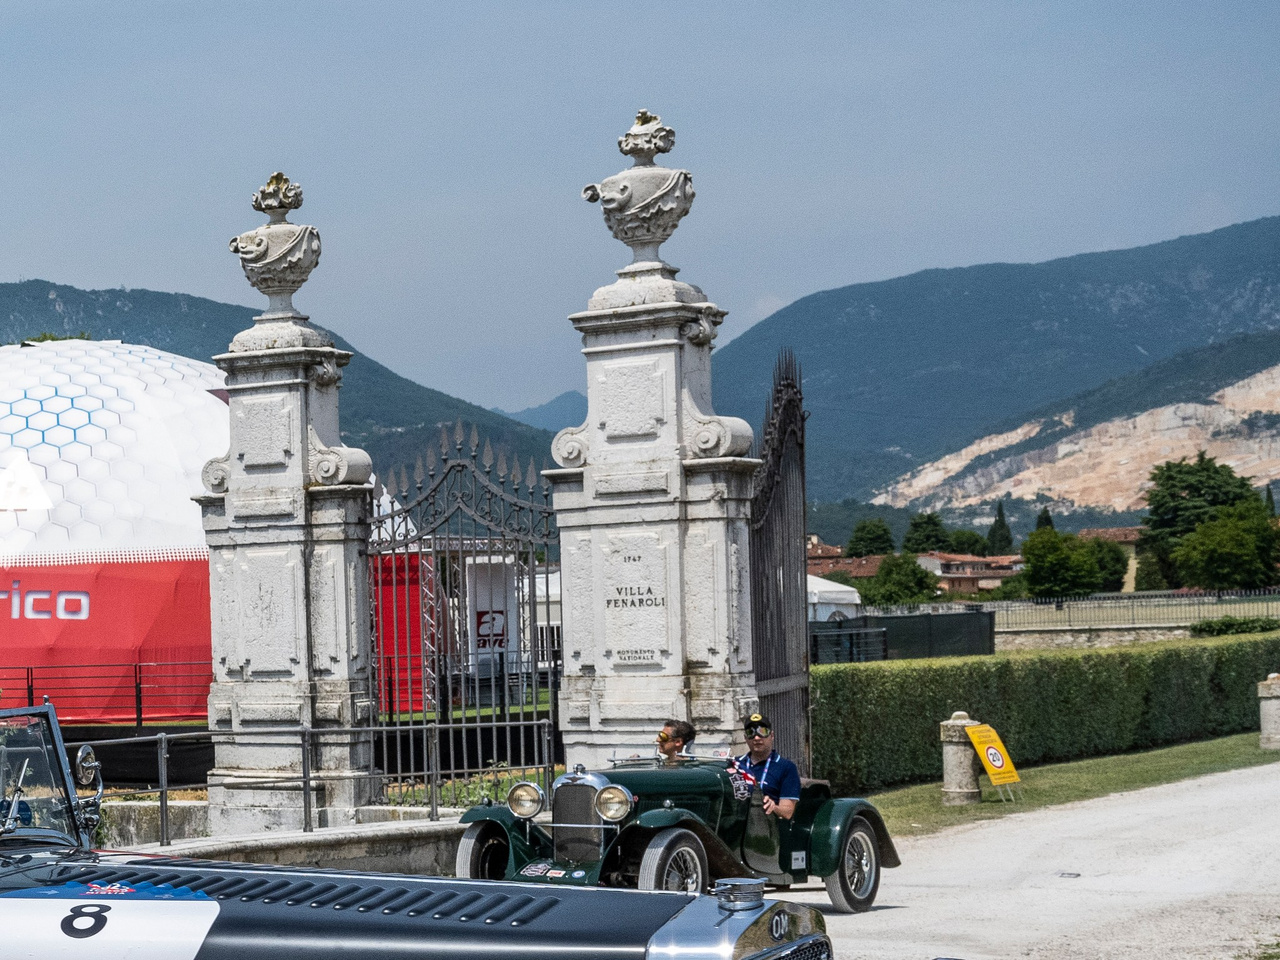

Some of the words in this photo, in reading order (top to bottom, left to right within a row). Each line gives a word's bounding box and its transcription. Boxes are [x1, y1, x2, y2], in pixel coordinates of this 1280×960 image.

[616, 587, 653, 596] VILLA
[606, 597, 665, 608] FENAROLI
[989, 752, 1001, 763] 20
[60, 903, 112, 939] 8
[772, 914, 789, 938] OM
